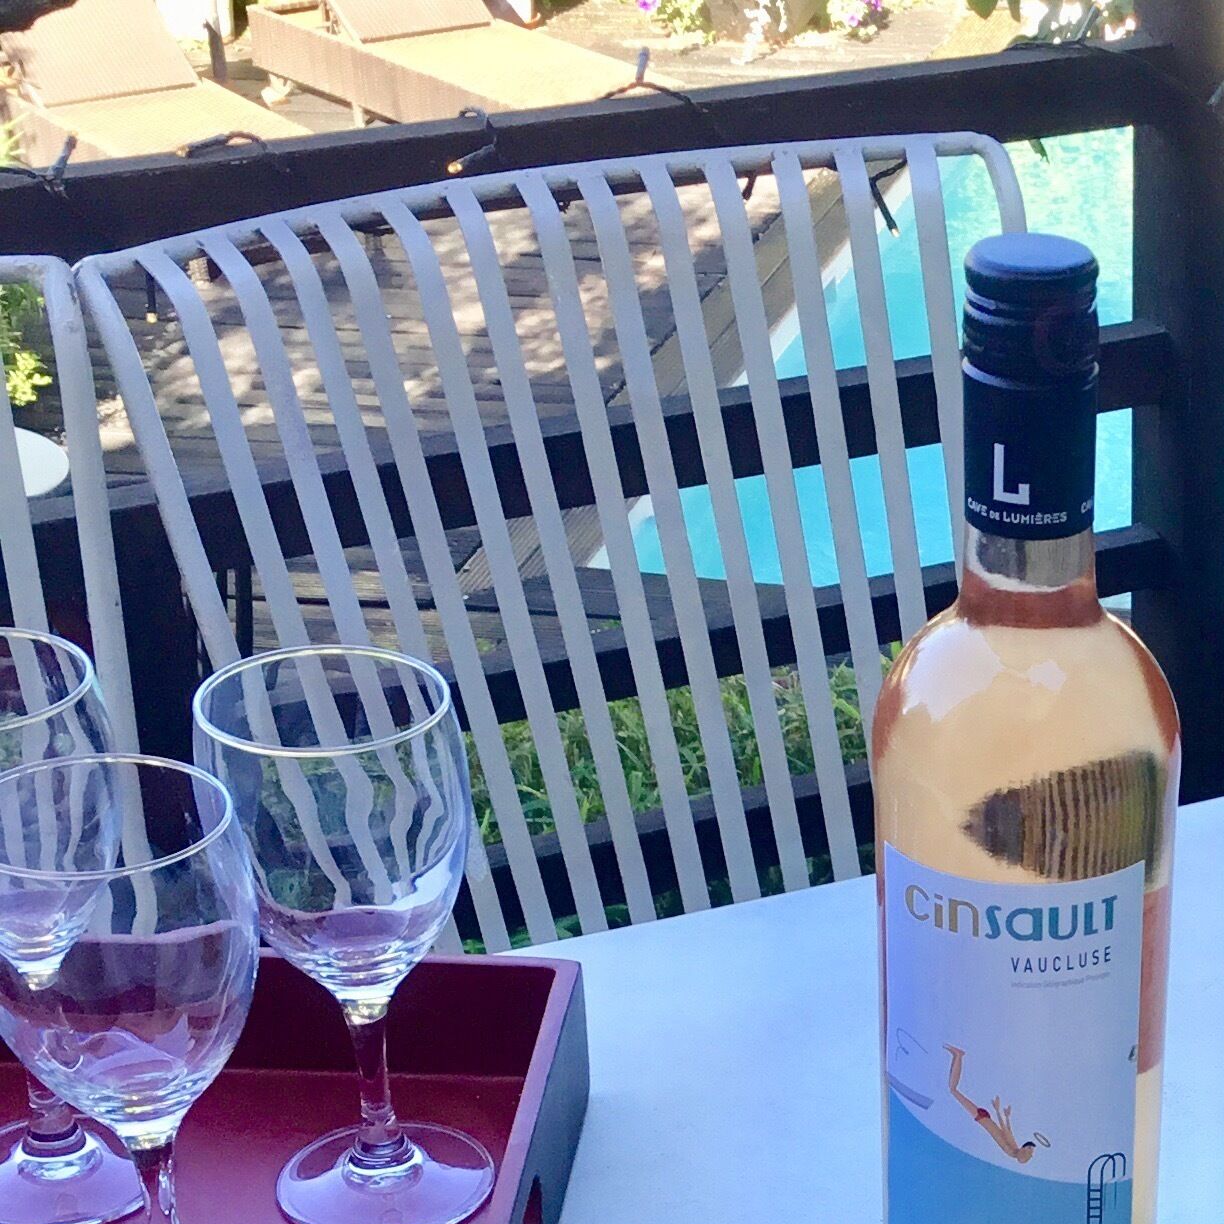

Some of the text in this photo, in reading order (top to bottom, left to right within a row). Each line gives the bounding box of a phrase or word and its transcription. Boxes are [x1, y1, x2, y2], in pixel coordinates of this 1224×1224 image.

[993, 443, 1030, 505] L
[967, 496, 987, 517] CAVE
[1010, 946, 1112, 974] VAUCLUSE
